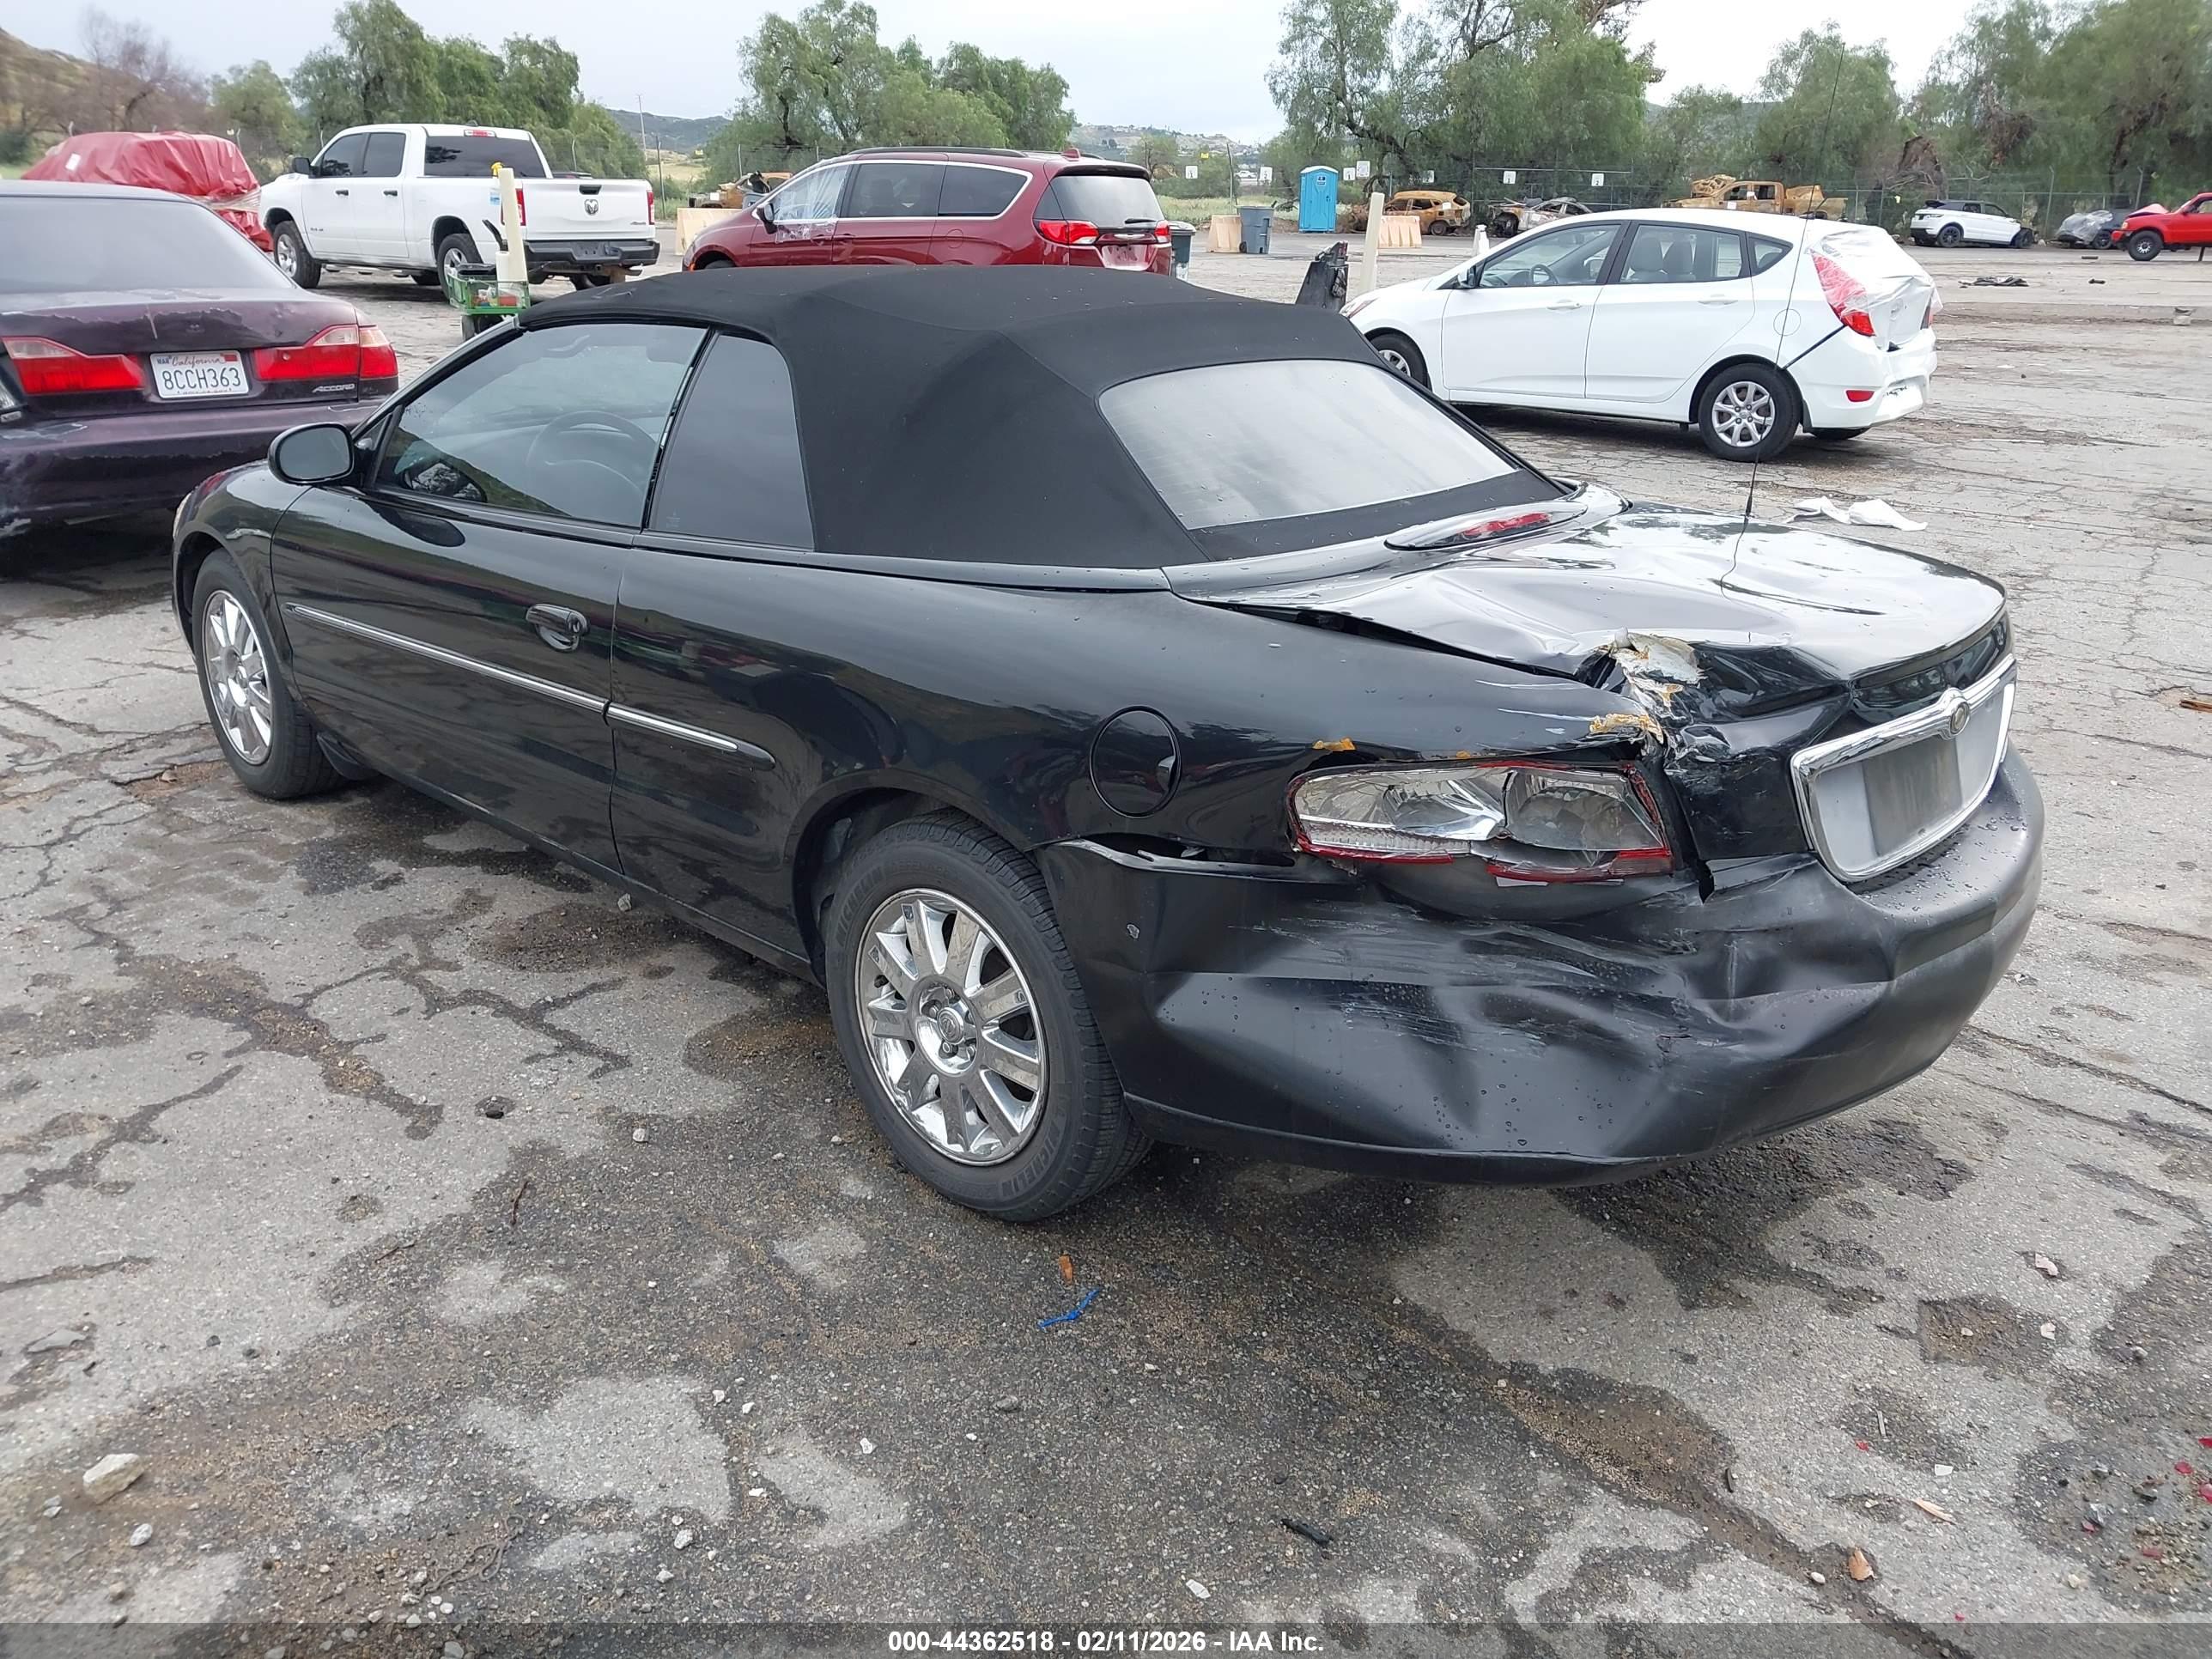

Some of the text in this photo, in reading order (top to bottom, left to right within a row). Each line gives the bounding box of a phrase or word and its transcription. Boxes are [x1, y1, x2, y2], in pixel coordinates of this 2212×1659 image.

[171, 356, 222, 368] California
[161, 367, 241, 390] 8CCH363
[312, 383, 356, 393] ACCORD
